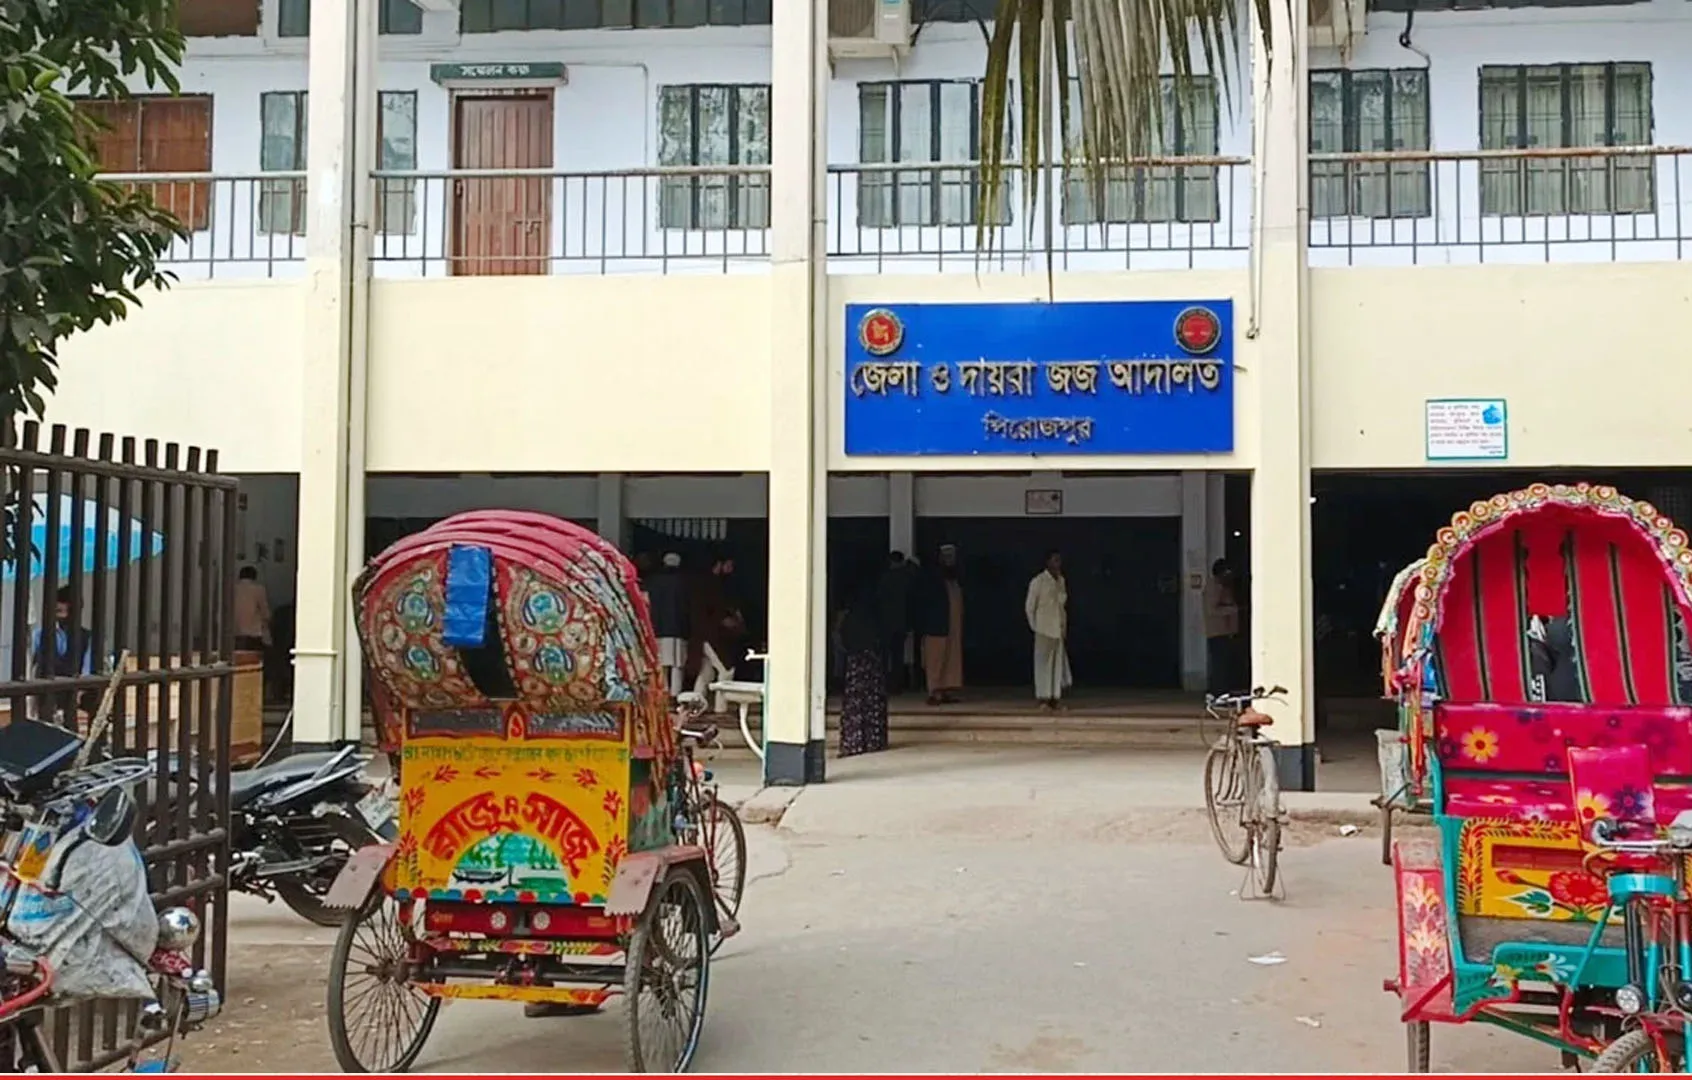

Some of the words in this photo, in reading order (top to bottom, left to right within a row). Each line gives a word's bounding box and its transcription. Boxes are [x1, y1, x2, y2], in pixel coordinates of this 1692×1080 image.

[851, 360, 922, 397] জেলা
[931, 363, 950, 392] ও
[956, 356, 1037, 397] দায়রা
[1042, 359, 1100, 395] জজ
[1102, 354, 1224, 395] আদালত
[982, 410, 1096, 444] পিরোজপুর
